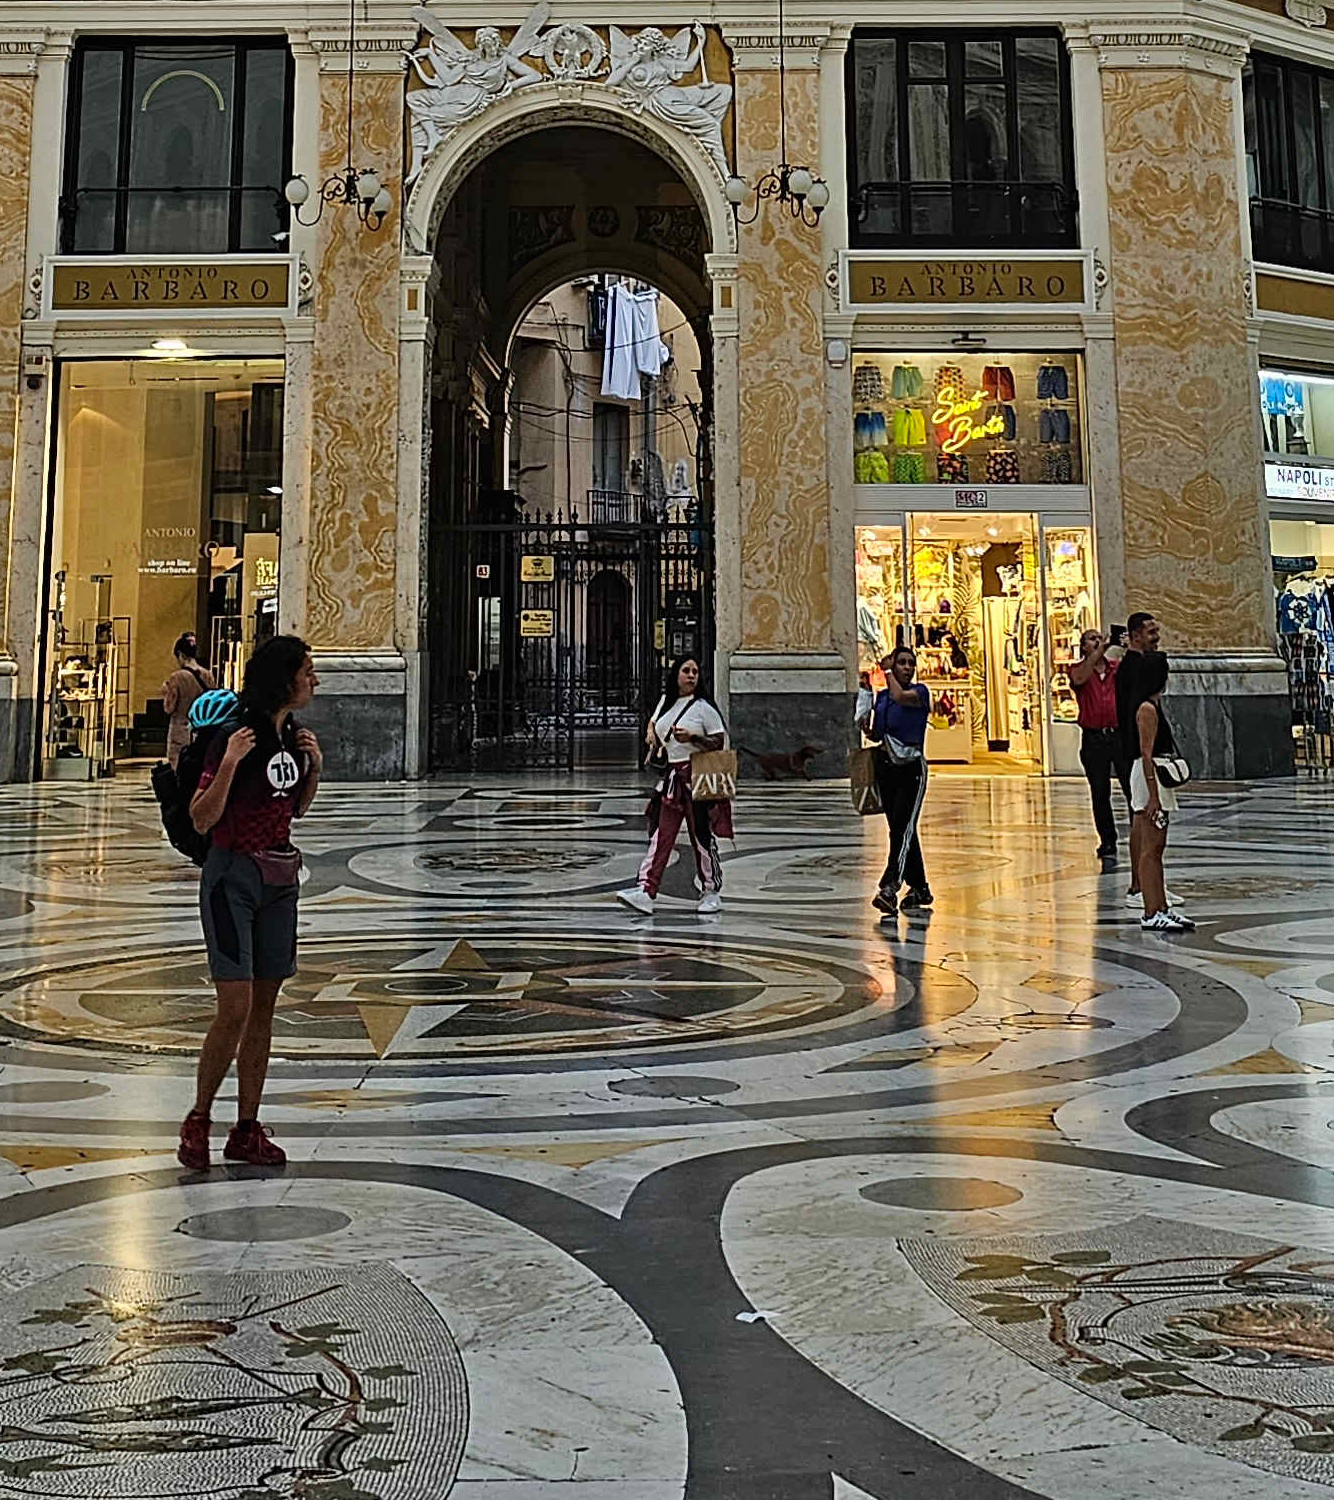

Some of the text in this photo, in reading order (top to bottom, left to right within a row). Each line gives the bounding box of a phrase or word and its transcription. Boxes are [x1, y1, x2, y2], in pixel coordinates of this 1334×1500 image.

[125, 267, 218, 280] ANTONIO
[920, 263, 1012, 276] ANTONIO
[73, 279, 270, 301] BARBARO
[869, 275, 1066, 298] BARBARO
[931, 386, 989, 424] Saint
[1277, 468, 1322, 486] NAPOLI
[145, 526, 196, 538] ANTONIO
